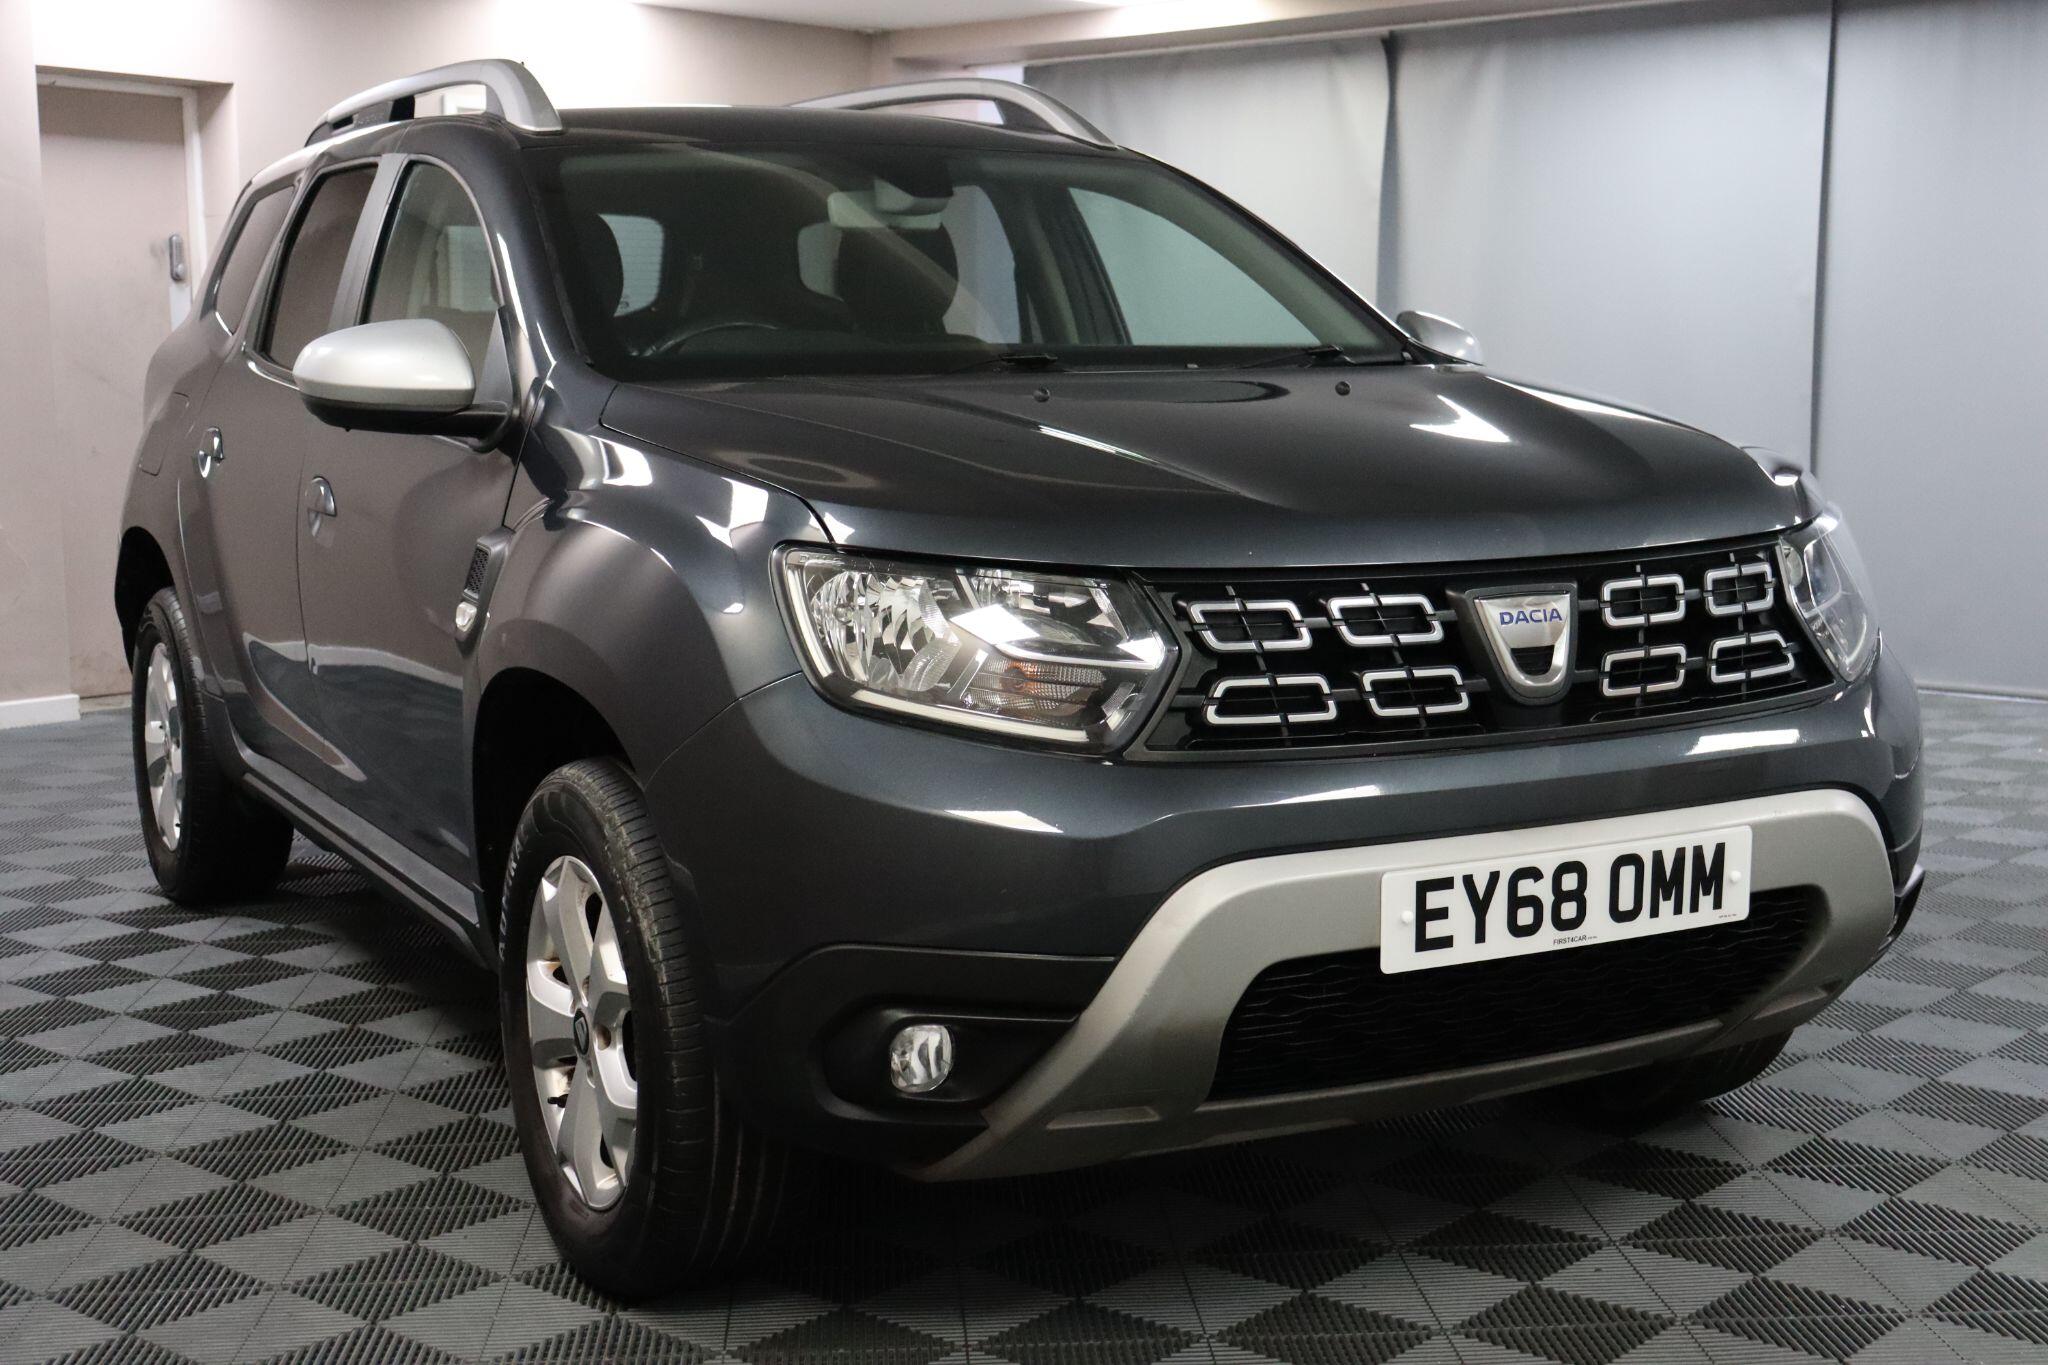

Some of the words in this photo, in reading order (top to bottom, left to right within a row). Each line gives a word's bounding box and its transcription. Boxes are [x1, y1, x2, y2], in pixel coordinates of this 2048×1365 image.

[1499, 608, 1562, 625] DACIA
[1415, 860, 1588, 952] EY68
[1609, 842, 1726, 923] OMM
